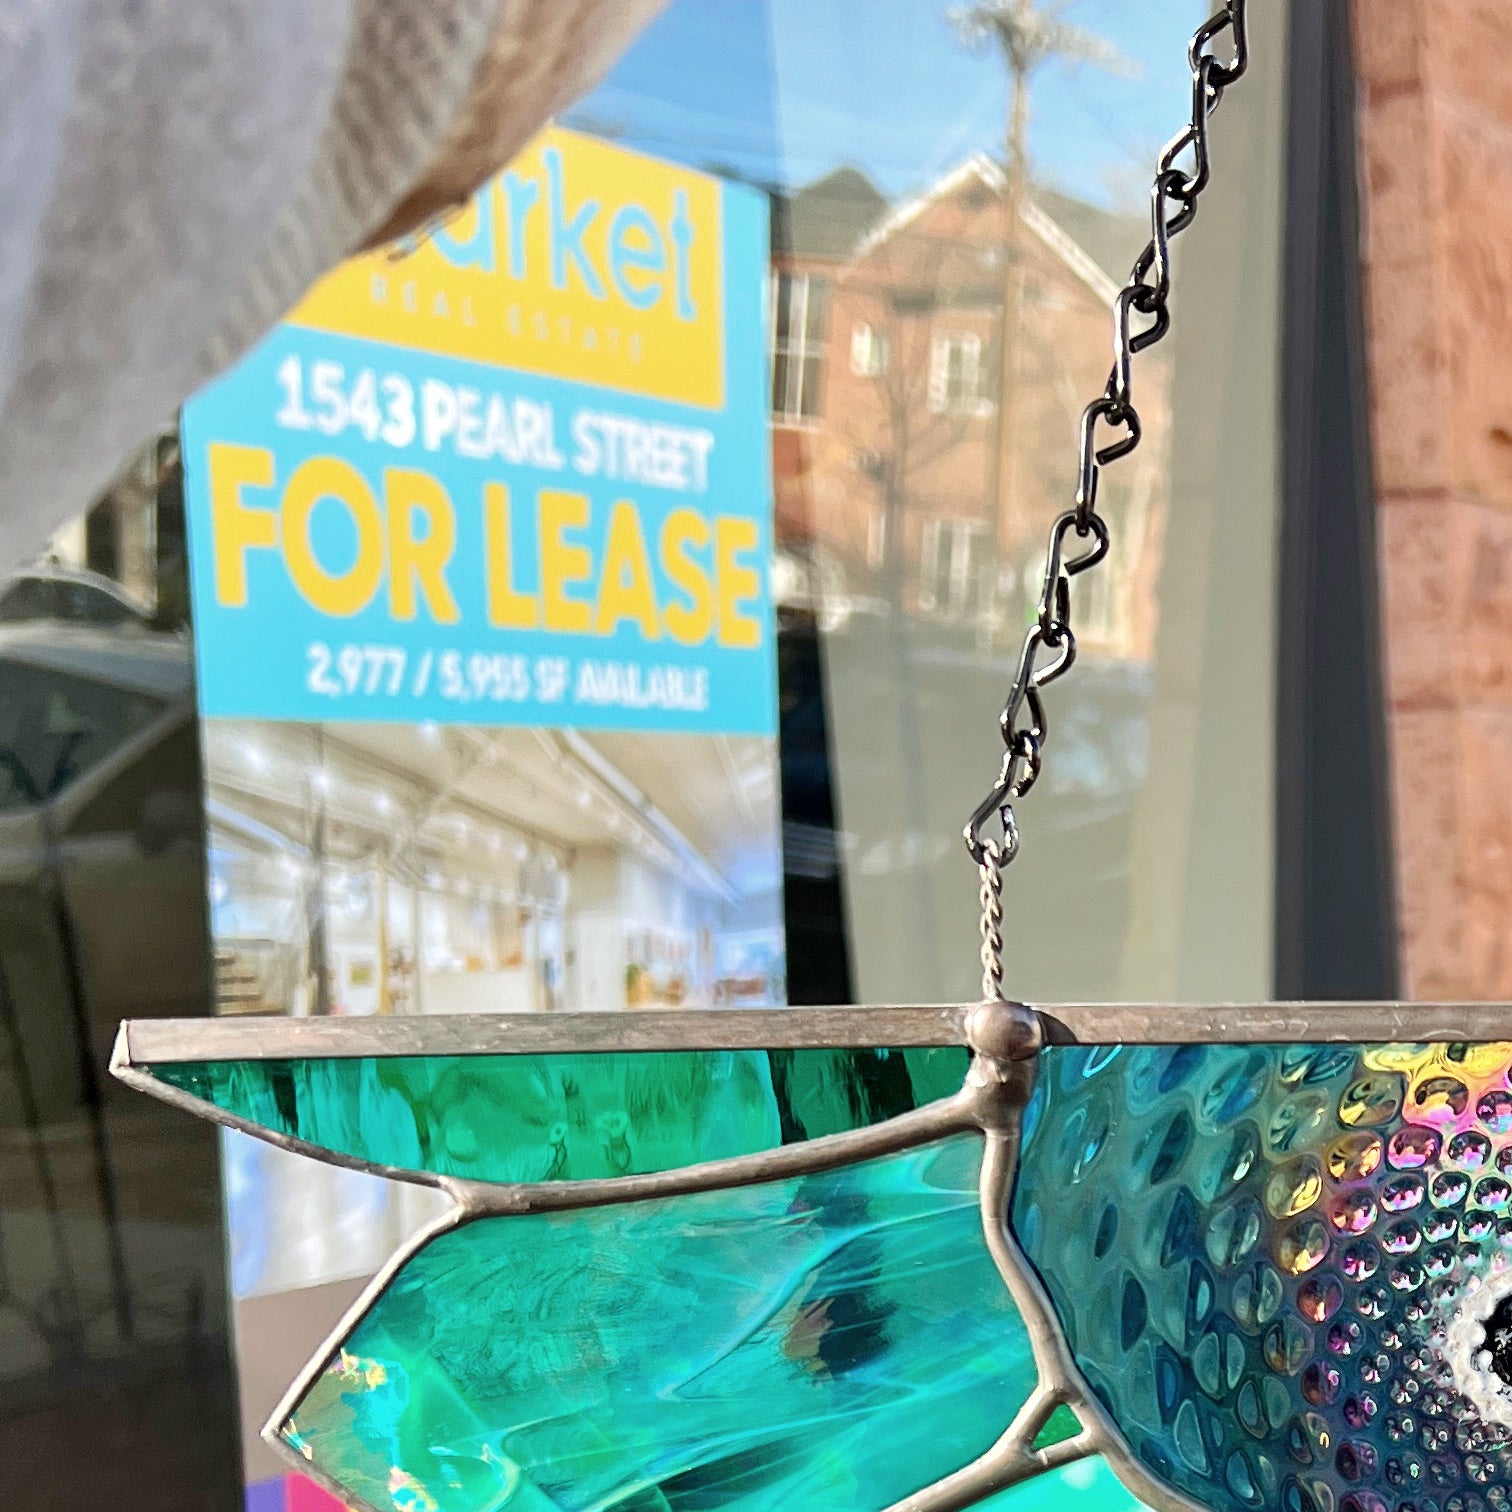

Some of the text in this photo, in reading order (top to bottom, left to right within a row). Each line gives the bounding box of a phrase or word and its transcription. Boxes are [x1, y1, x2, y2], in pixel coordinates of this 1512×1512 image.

[371, 273, 645, 364] REAL ESTATE
[276, 355, 715, 492] 1543 PEARL STREET
[208, 441, 762, 647] FOR LEASE
[306, 643, 405, 697] 2,977
